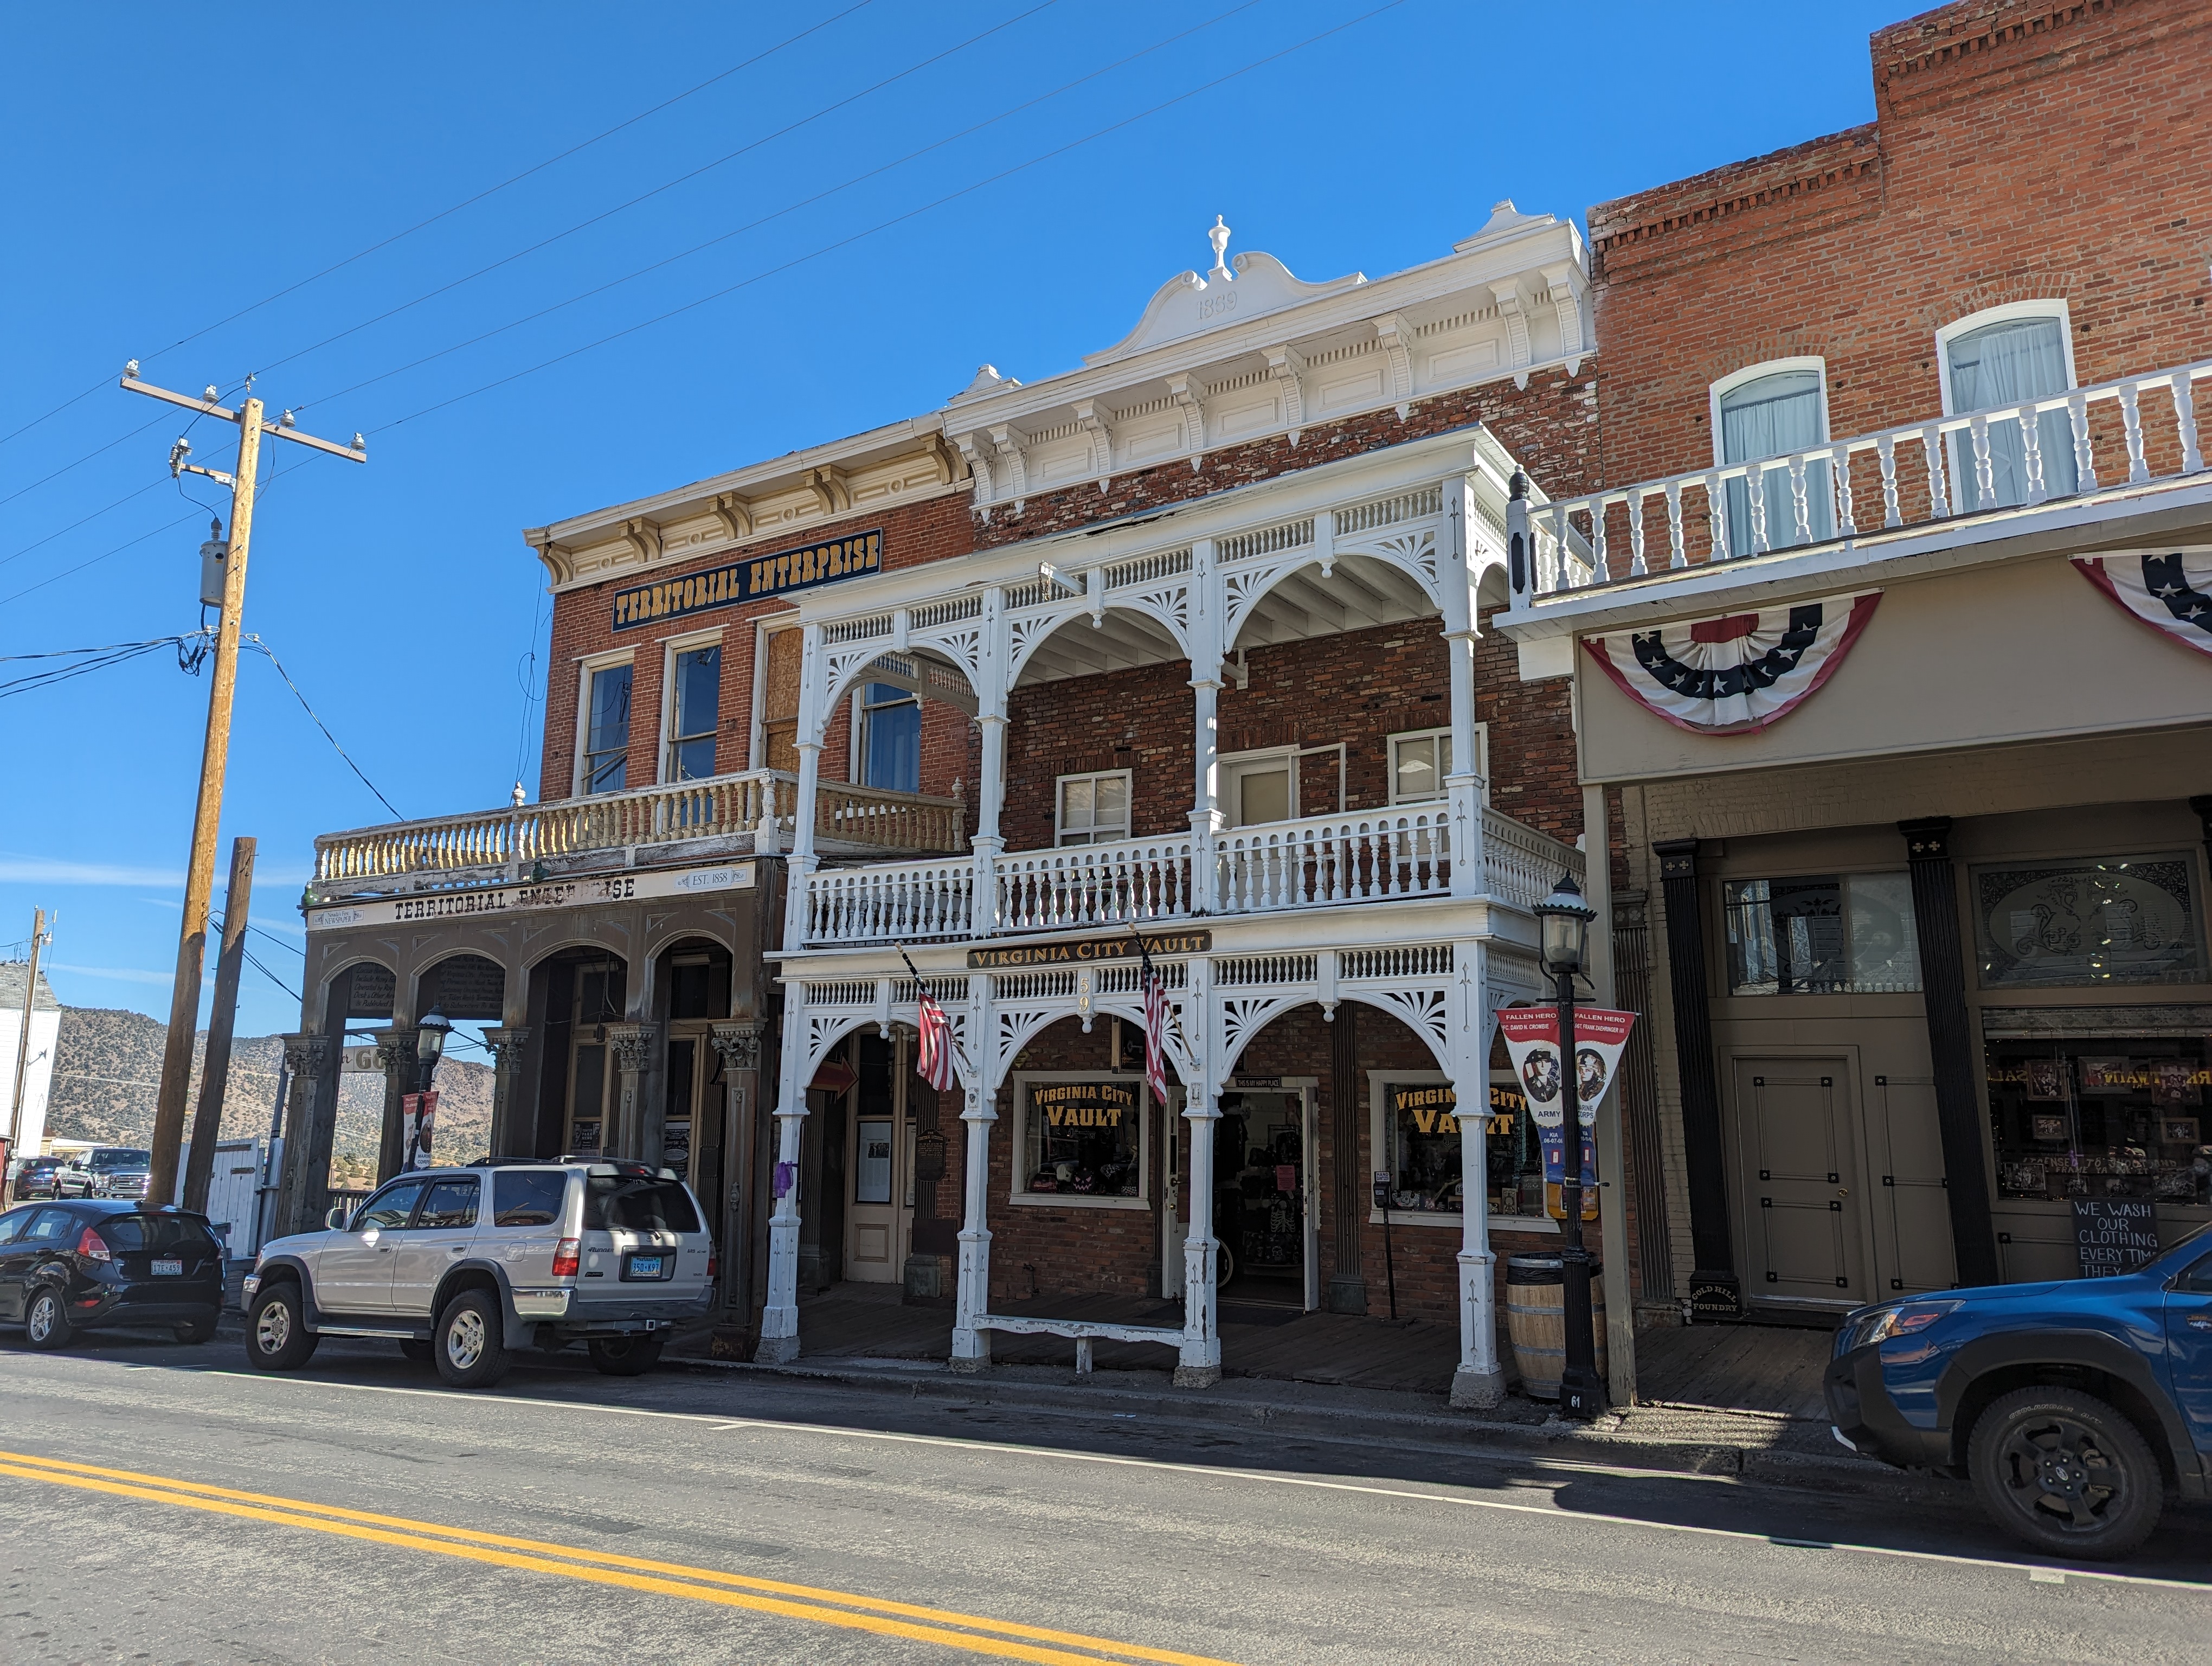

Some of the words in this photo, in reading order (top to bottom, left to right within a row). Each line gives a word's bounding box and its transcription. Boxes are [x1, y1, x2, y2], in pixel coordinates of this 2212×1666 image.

[1197, 291, 1238, 321] 1869
[616, 568, 740, 624] TERRITORIAL
[749, 534, 879, 595] ENTERPRISE
[693, 874, 709, 886] EST.
[712, 872, 728, 884] 1858
[396, 891, 505, 921] TERRITORIAL
[325, 916, 352, 925] NEWSPAPER
[973, 946, 1071, 967] VIRGINIA
[1076, 941, 1128, 958] CITY
[1506, 1013, 1533, 1021] FALLEN
[1535, 1012, 1557, 1020] HERO
[1574, 1013, 1602, 1021] FALLEN
[1604, 1015, 1625, 1023] HERO
[1034, 1085, 1098, 1106] VIRGINIA
[1101, 1084, 1133, 1106] CITY
[1396, 1087, 1457, 1111] VIRGIN
[1489, 1087, 1527, 1112] CITY
[1045, 1105, 1122, 1126] VAULT
[1411, 1108, 1514, 1135] VAT
[2056, 1166, 2090, 1174] FRAME
[2095, 1166, 2108, 1174] YA
[2074, 1201, 2100, 1216] WE
[2107, 1202, 2151, 1218] WASH
[2097, 1217, 2130, 1232] OUR
[2079, 1229, 2158, 1248] CLOTHING
[2080, 1247, 2124, 1262] EVERY
[2125, 1248, 2157, 1263] TIM
[2080, 1264, 2121, 1278] THEY
[1692, 1285, 1713, 1300] GOLD
[1714, 1286, 1737, 1303] HILL
[1693, 1303, 1738, 1312] FOUNDRY
[1571, 1395, 1580, 1409] 61
